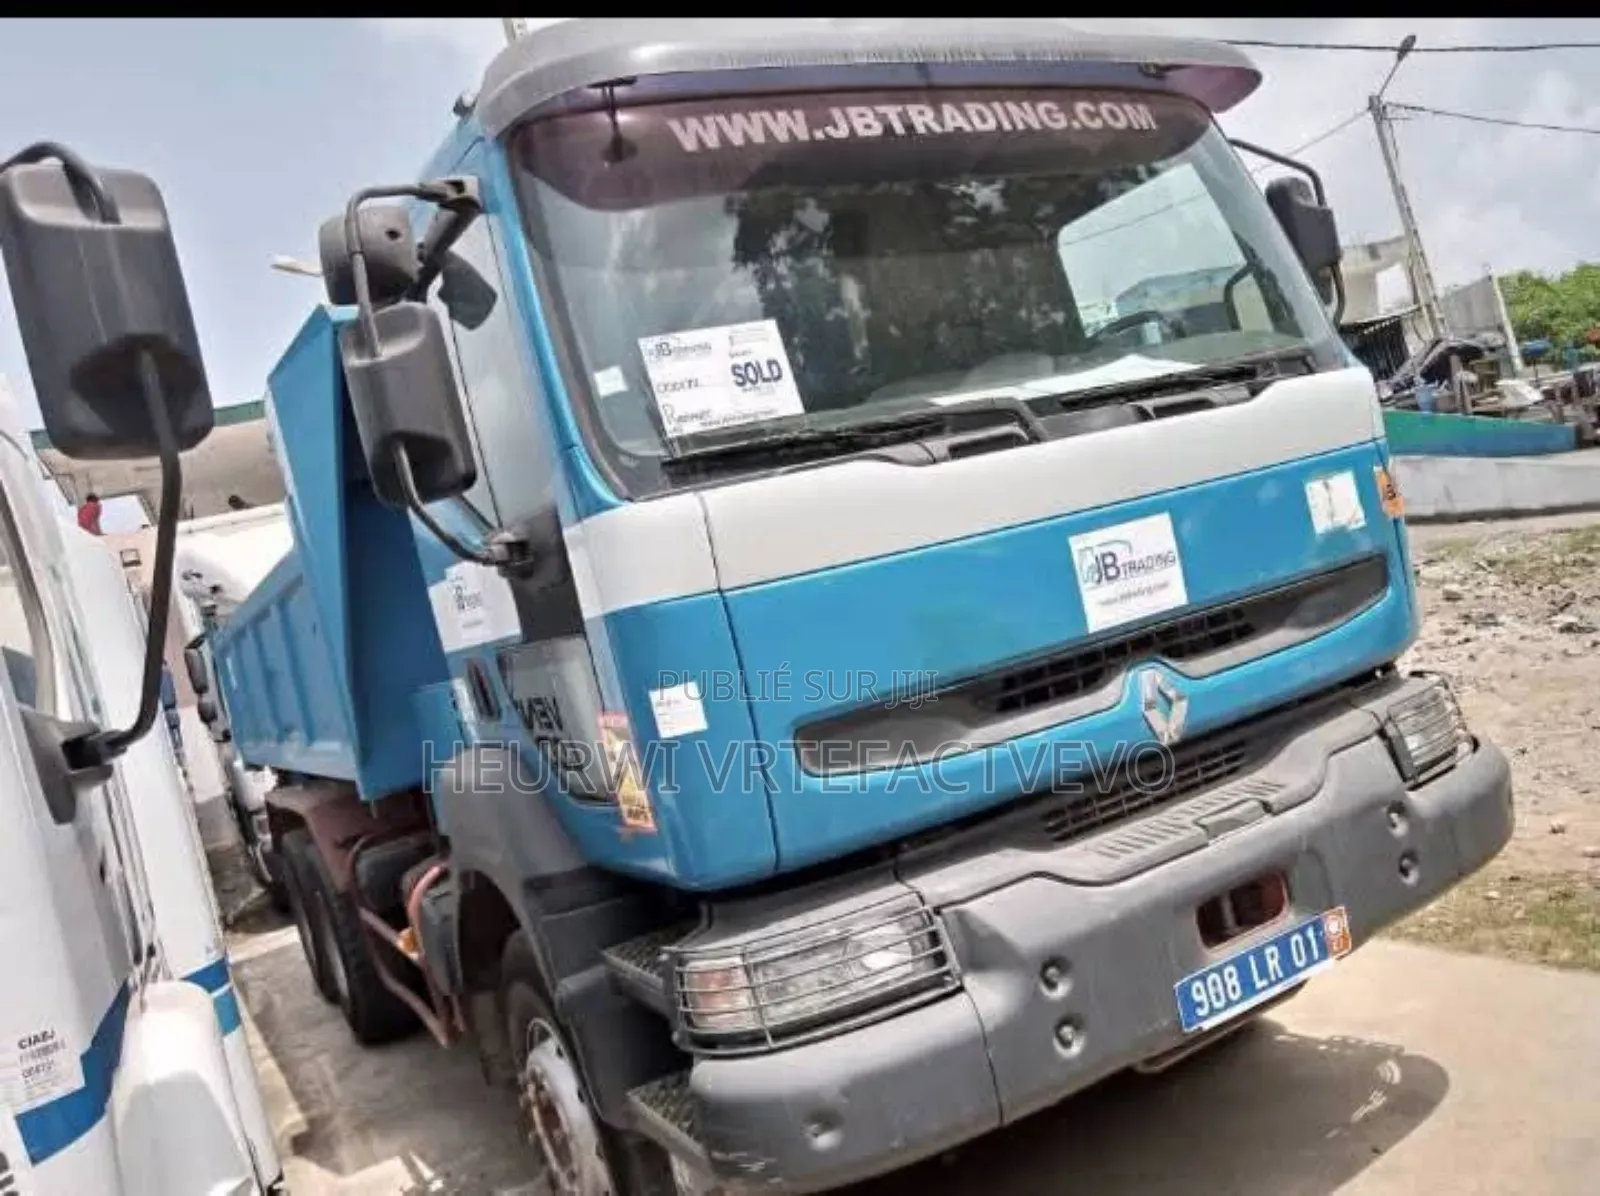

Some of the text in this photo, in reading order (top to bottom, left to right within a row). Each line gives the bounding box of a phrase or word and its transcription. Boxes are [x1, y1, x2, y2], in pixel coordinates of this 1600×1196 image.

[667, 102, 1157, 152] WWW.JBTRADING.COM
[731, 359, 782, 388] SOLD
[1191, 925, 1319, 1016] 908 LR 01
